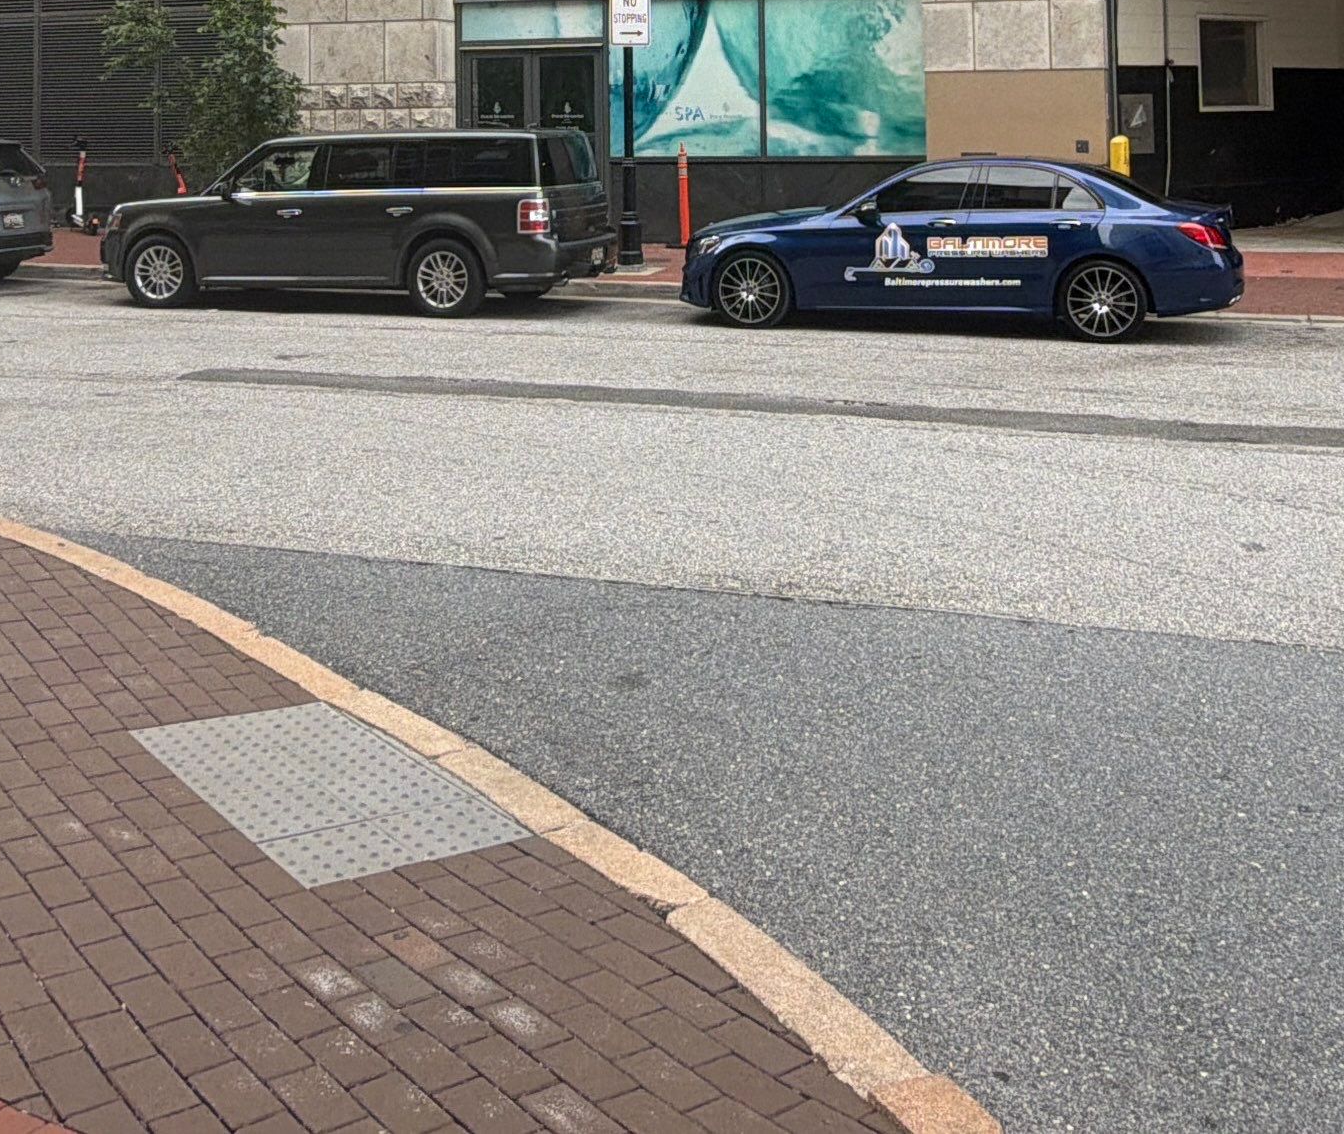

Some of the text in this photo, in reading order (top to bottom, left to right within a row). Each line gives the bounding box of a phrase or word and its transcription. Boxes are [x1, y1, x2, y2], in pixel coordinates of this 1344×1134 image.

[613, 13, 647, 23] STOPPING
[675, 106, 705, 121] SPA
[927, 237, 1048, 250] BALTIMORE
[884, 277, 1022, 287] Baltimorepressurewashers.com
